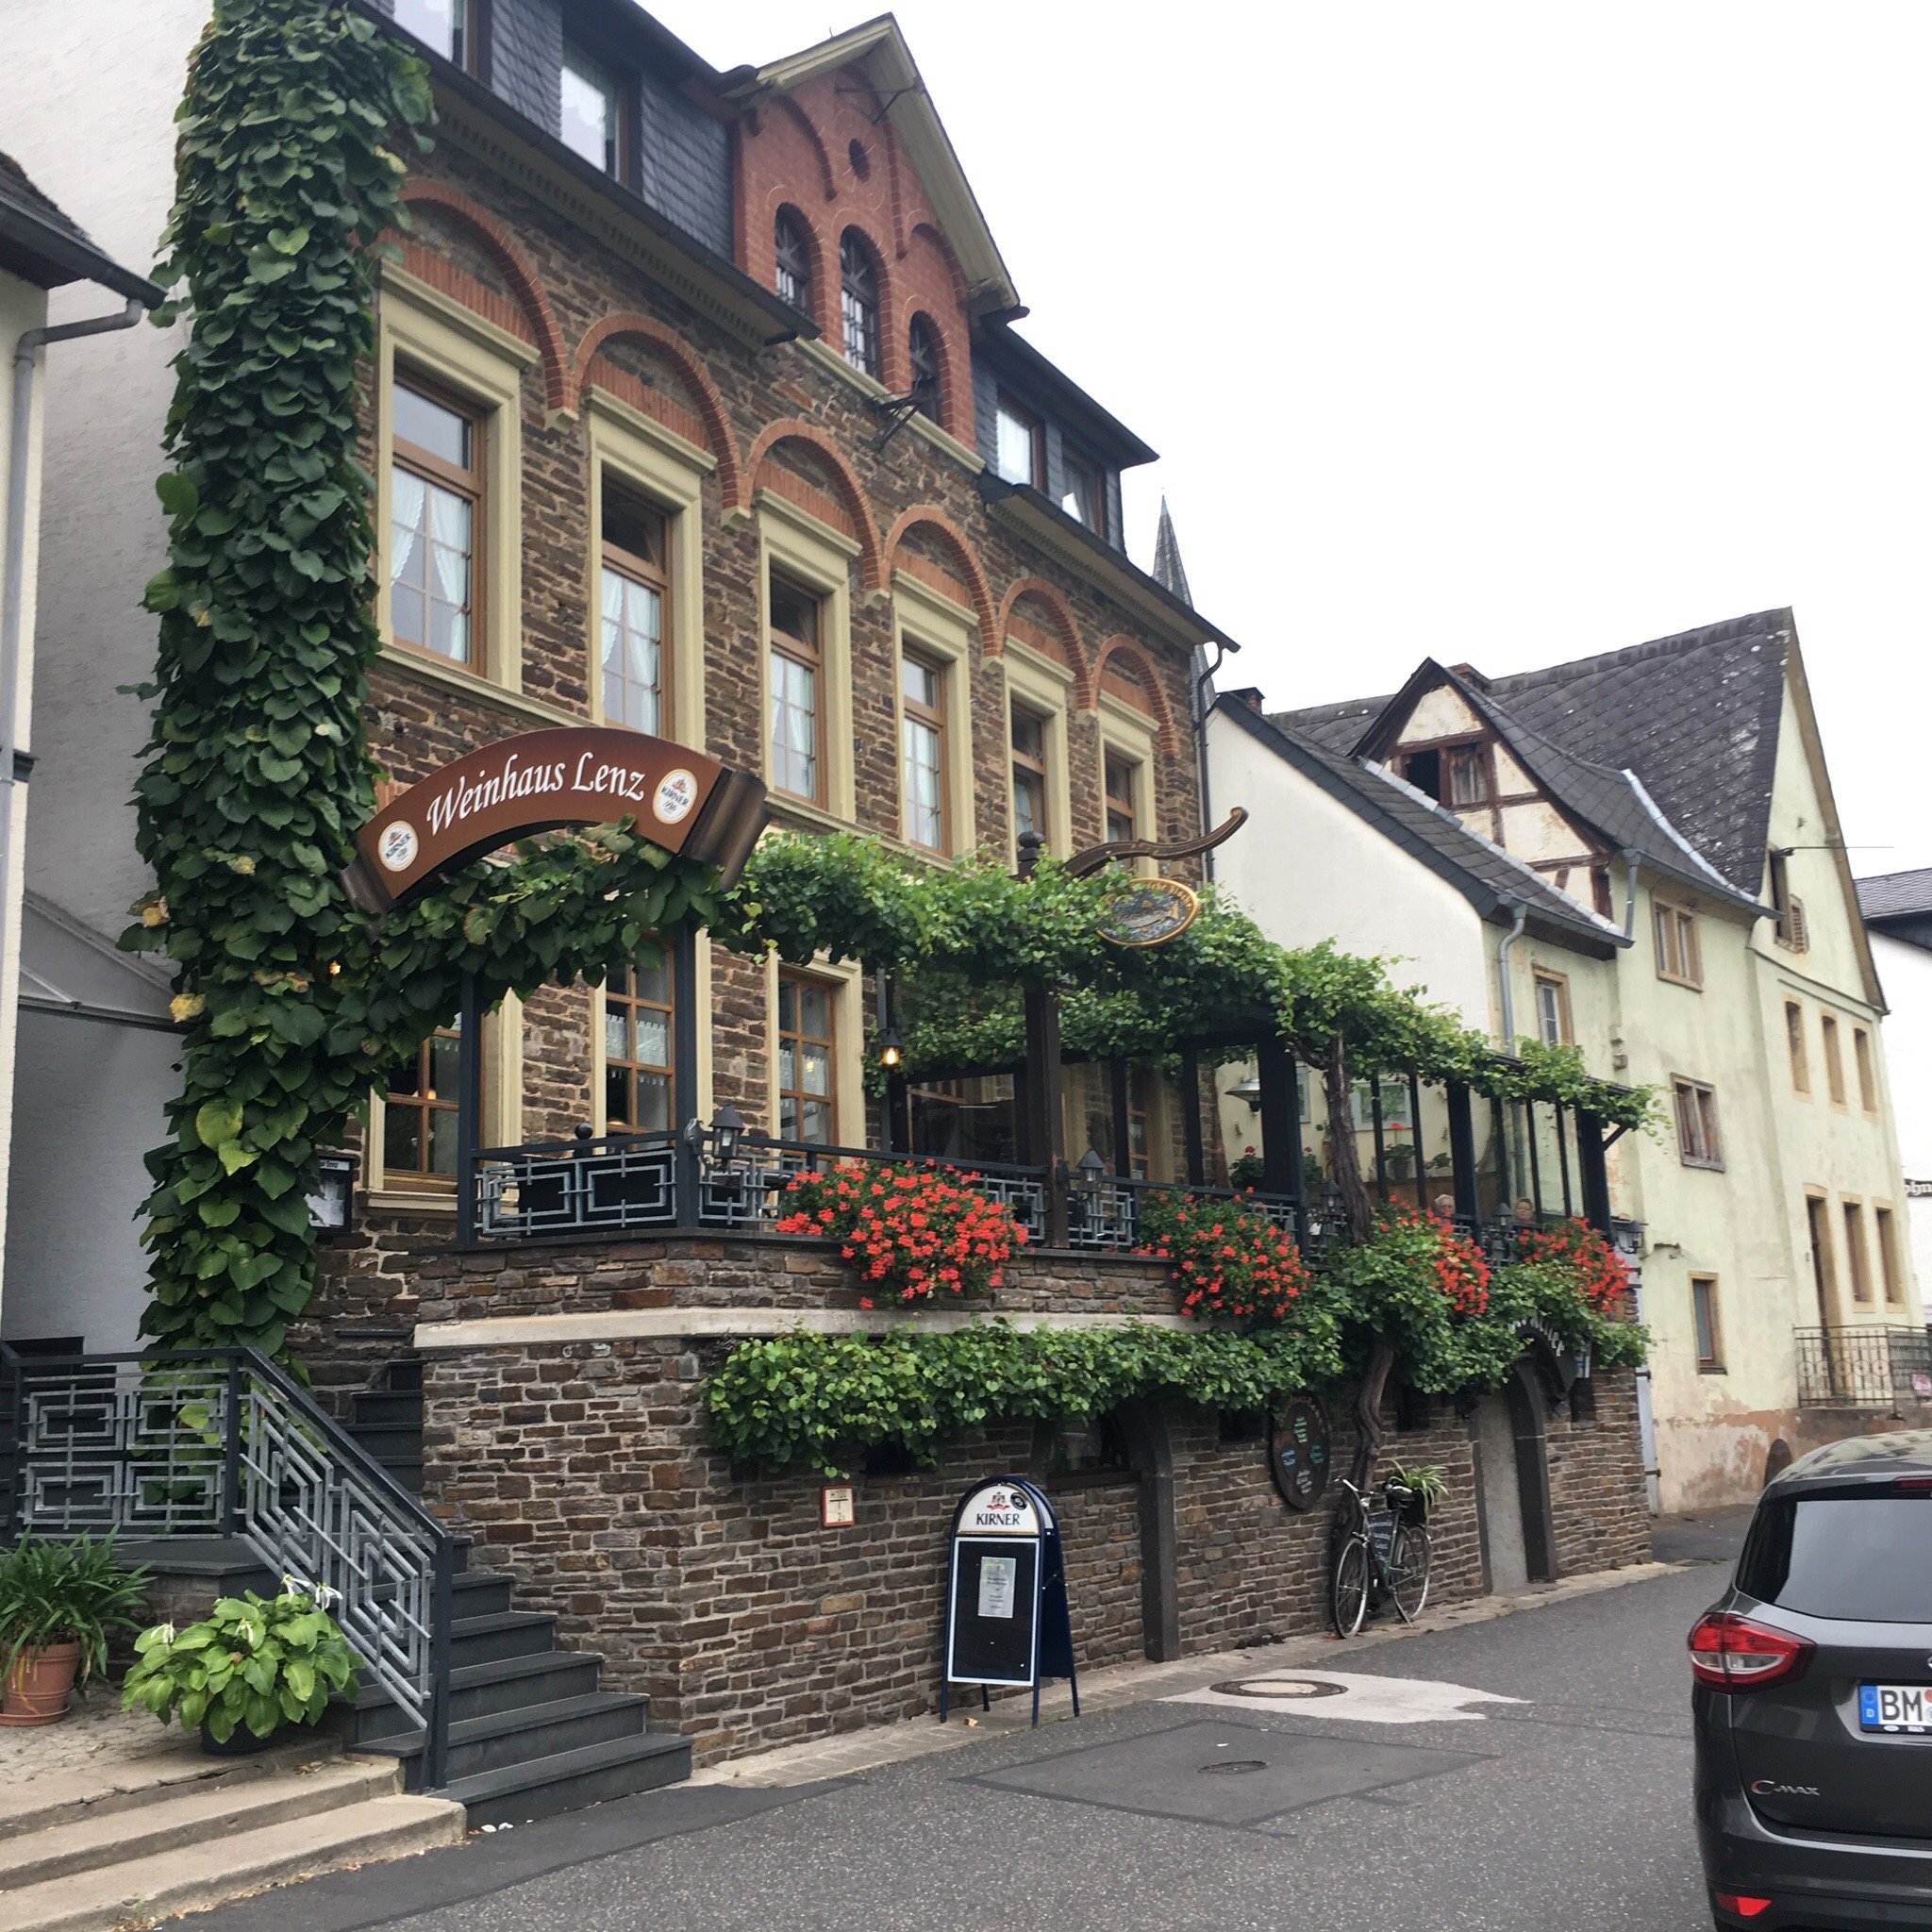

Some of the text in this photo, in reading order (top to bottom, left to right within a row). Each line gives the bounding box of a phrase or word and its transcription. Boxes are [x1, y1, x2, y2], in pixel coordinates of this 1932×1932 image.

[426, 752, 645, 836] Weinhaus Lenz
[975, 1513, 1021, 1526] KIRNER
[1866, 1708, 1875, 1718] D
[1880, 1690, 1924, 1722] BM
